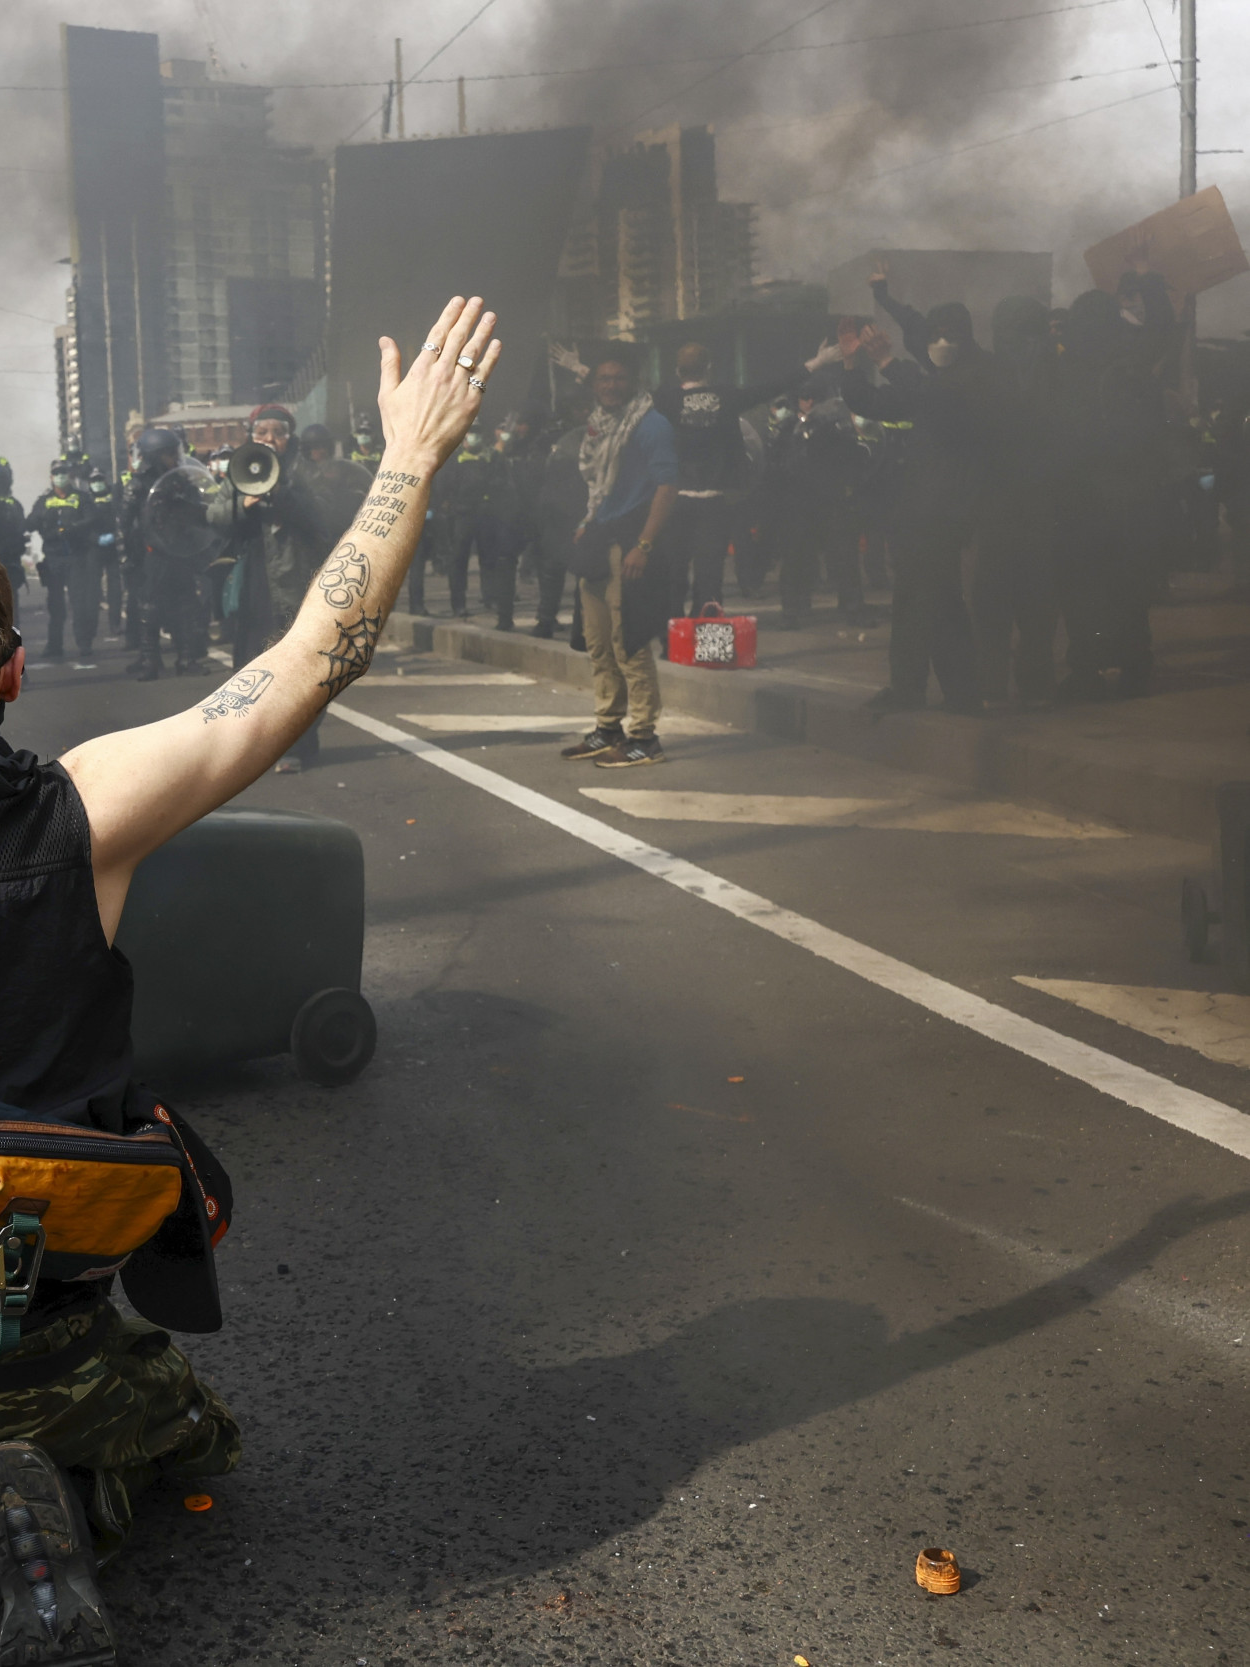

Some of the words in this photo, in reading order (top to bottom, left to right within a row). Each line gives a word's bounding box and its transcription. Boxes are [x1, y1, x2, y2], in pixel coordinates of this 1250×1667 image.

[381, 481, 390, 492] A
[396, 472, 421, 487] DEAD
[387, 483, 403, 494] OF
[387, 497, 407, 515] THE
[373, 510, 398, 526] ROT
[372, 525, 391, 538] MY
